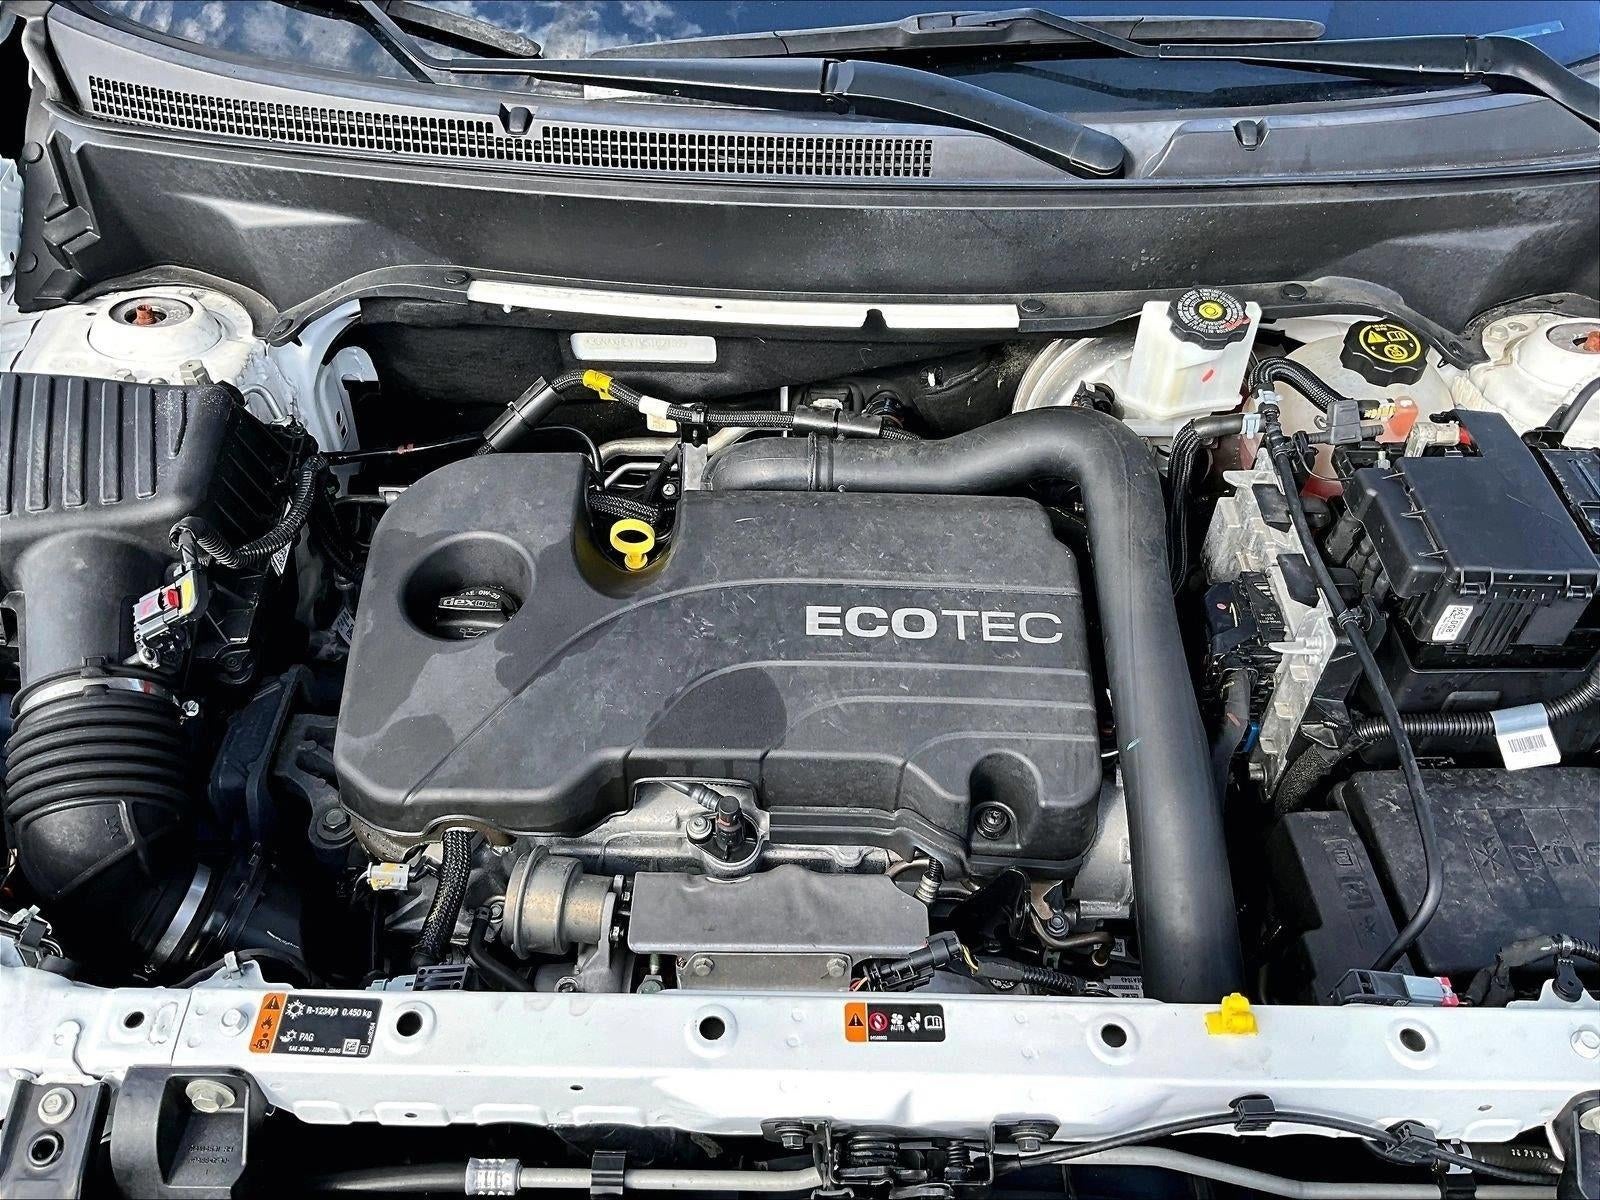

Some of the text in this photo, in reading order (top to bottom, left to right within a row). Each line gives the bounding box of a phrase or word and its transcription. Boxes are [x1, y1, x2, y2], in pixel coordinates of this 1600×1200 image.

[478, 590, 501, 600] 0W-20
[443, 598, 498, 609] dexos
[805, 606, 1063, 644] ECOTEC
[306, 1006, 373, 1019] R-1234yf 0.450 kg
[299, 1032, 315, 1041] PAG
